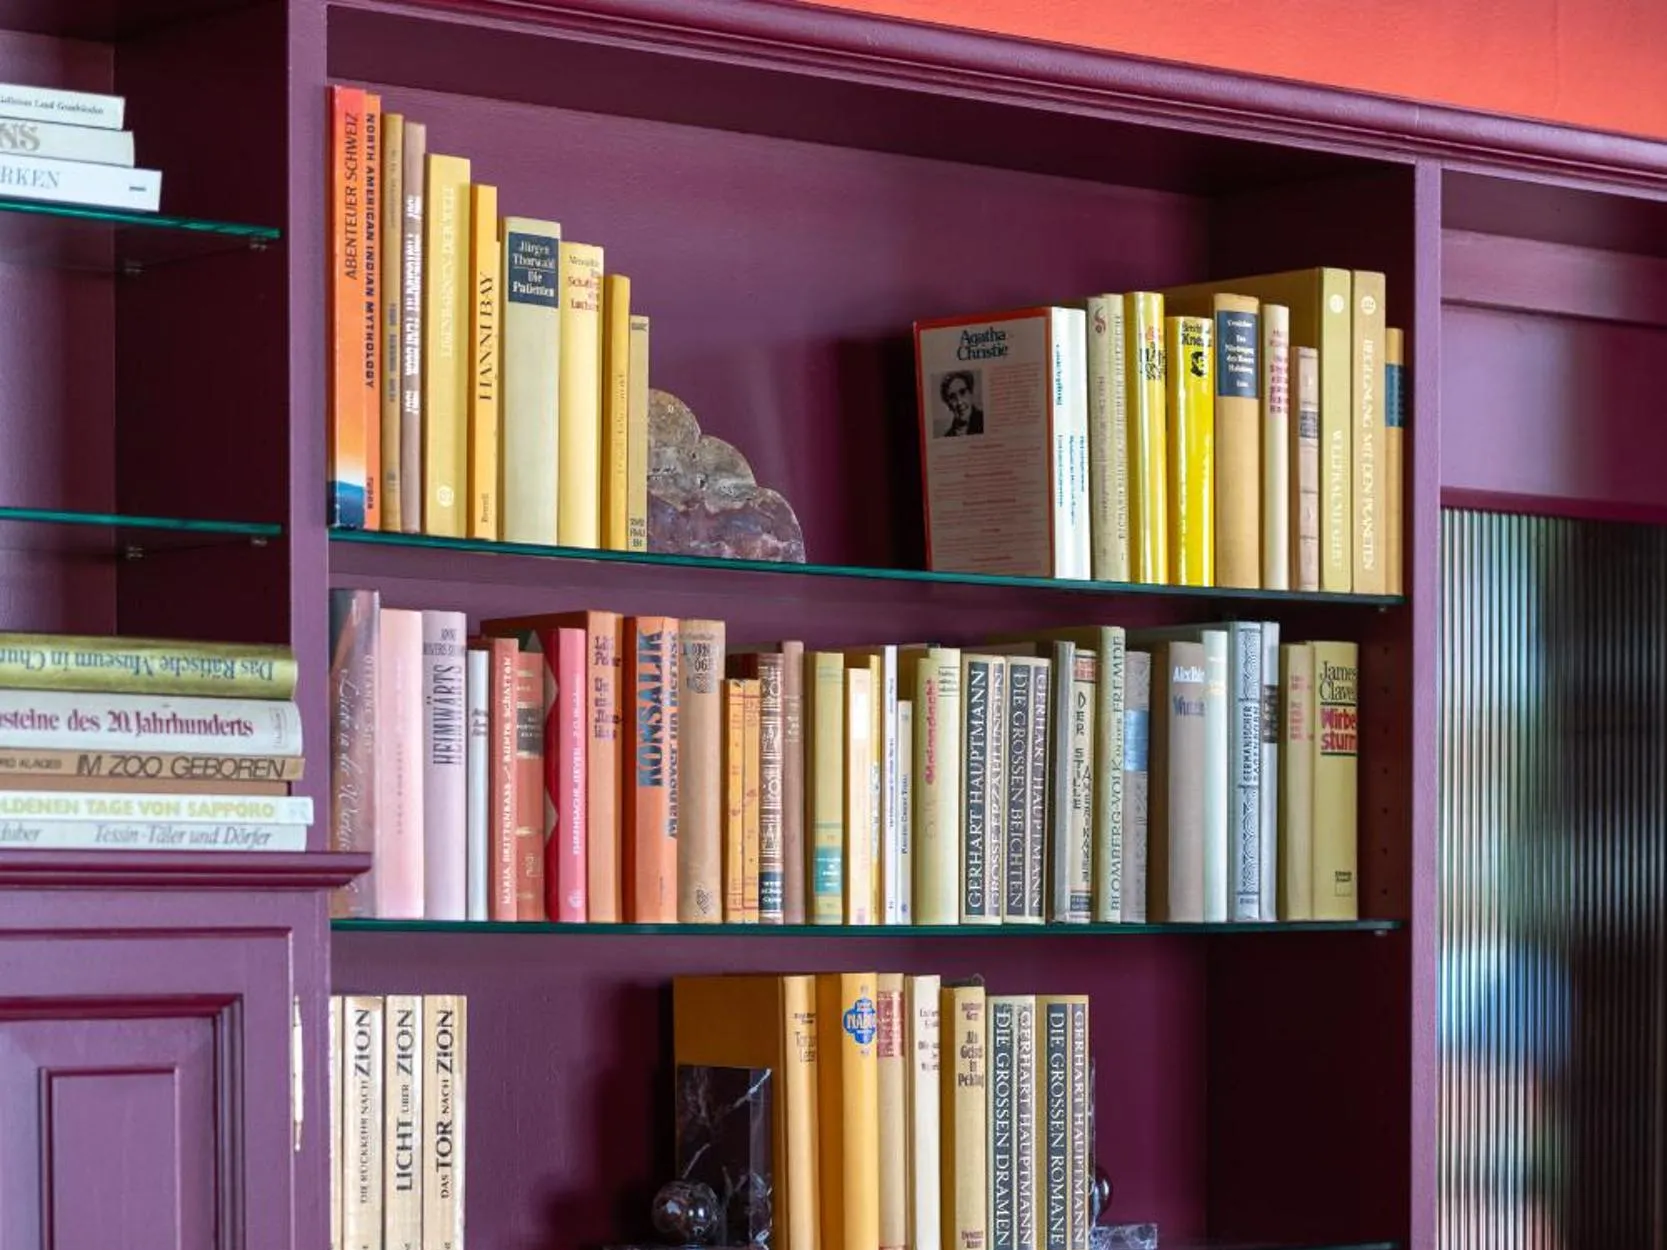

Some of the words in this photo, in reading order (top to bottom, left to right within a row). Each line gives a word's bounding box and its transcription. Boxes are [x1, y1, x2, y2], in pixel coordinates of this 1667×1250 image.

[345, 112, 359, 181] SCHWEIZ
[365, 113, 376, 161] NORTH
[344, 187, 358, 281] ABENTEUER
[365, 166, 375, 246] AMERICAN
[365, 247, 375, 298] INDIAN
[365, 301, 375, 389] MYTHOLOGY
[956, 345, 1009, 361] Christie
[961, 326, 1007, 347] Agatha
[50, 649, 71, 669] in
[73, 649, 154, 677] Museum
[159, 655, 236, 681] Rätische
[240, 661, 274, 682] Das
[1011, 673, 1028, 705] DIE
[67, 708, 101, 733] des
[134, 711, 255, 738] Jahrhunderts
[426, 663, 463, 766] HEIMWÄRTS
[636, 630, 664, 788] KONSALIK
[967, 668, 986, 804] HAUPTMANN
[76, 754, 103, 776] IM
[108, 754, 163, 778] ZOO
[170, 756, 287, 780] GEBOREN
[1011, 710, 1028, 802] GROSSEN
[967, 810, 986, 909] GERHART
[1010, 808, 1028, 908] BEICHTEN
[353, 1009, 371, 1077] ZION
[395, 1009, 413, 1076] ZION
[435, 1009, 453, 1075] ZION
[996, 1011, 1012, 1048] DIE
[1019, 1010, 1032, 1106] GERHART
[1050, 1011, 1065, 1047] DIE
[1072, 1010, 1085, 1107] GERHART
[440, 1079, 450, 1114] NACH
[996, 1052, 1012, 1141] GROSSEN
[1050, 1052, 1065, 1148] GROSSEN
[395, 1116, 413, 1192] LICHT
[435, 1121, 453, 1173] TOR
[1019, 1113, 1034, 1245] HAUPTMANN
[1072, 1112, 1086, 1244] HAUPTMANN
[440, 1174, 450, 1199] DAS
[996, 1154, 1013, 1246] DRAMEN
[1050, 1154, 1066, 1245] ROMANE
